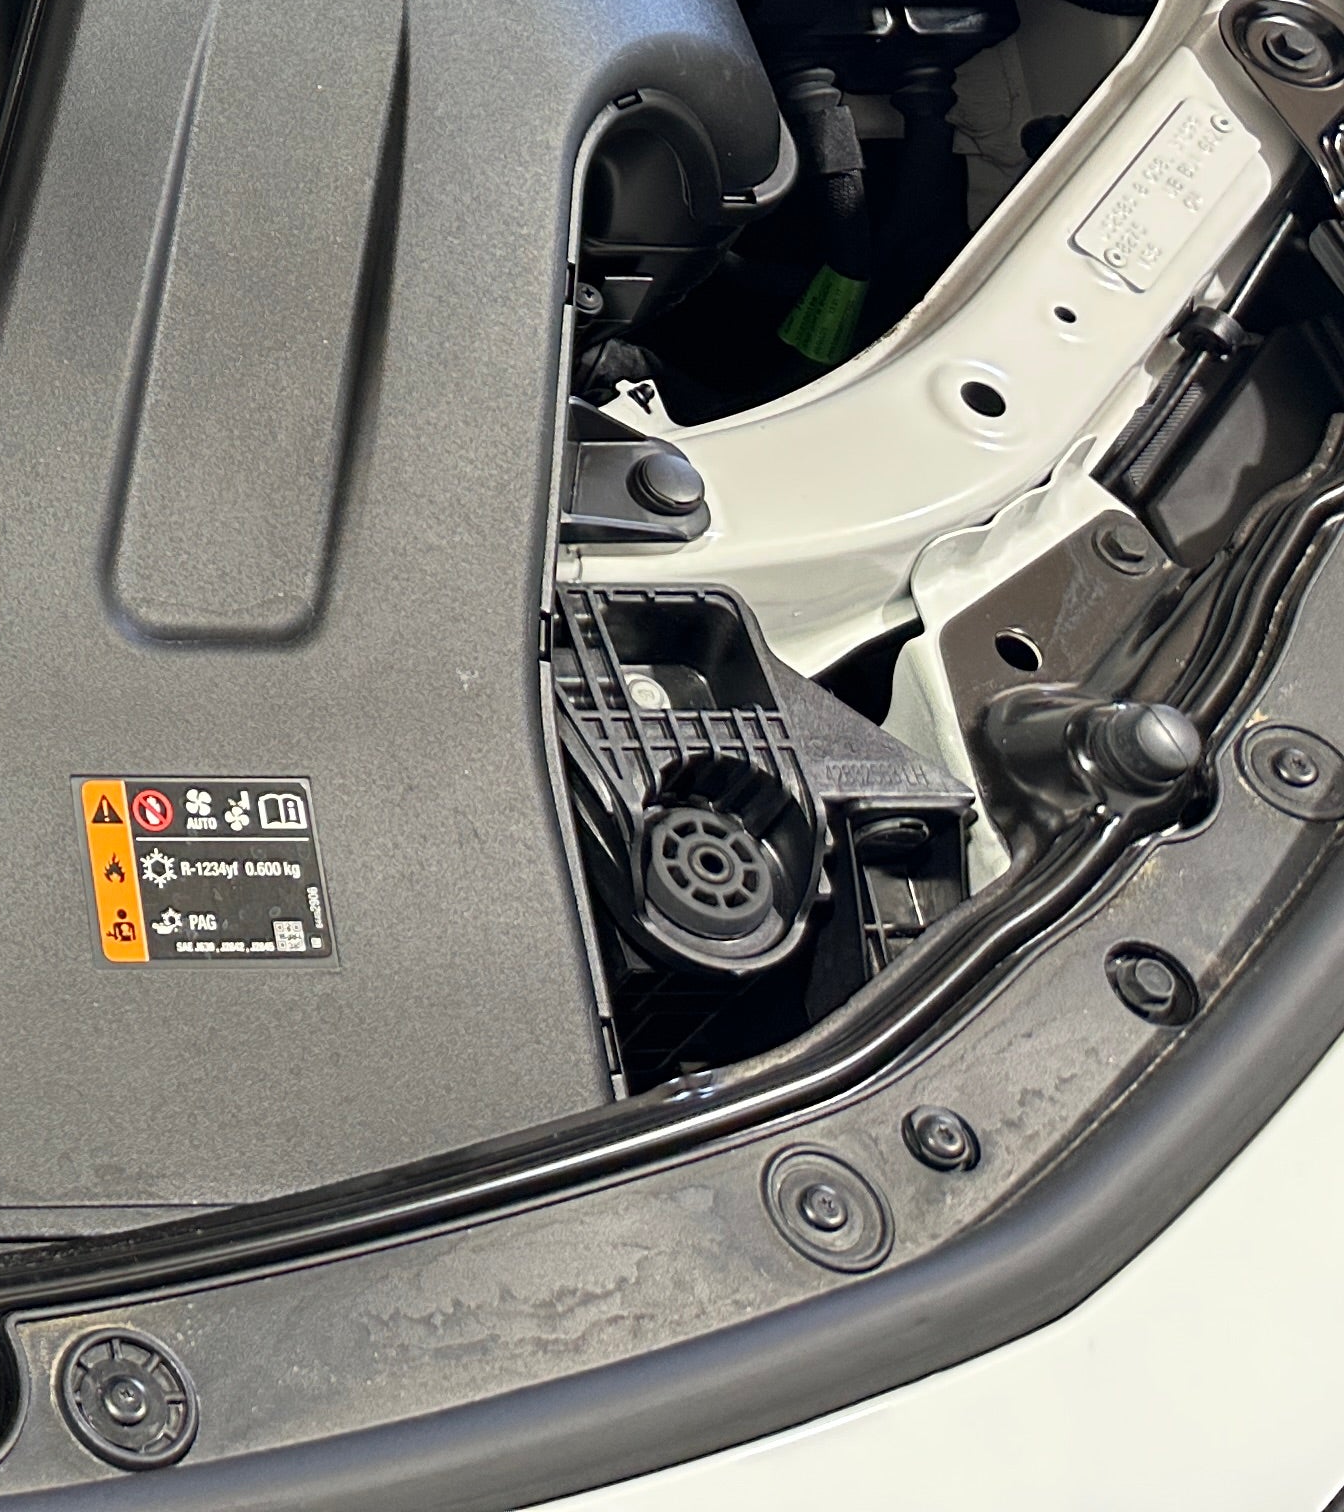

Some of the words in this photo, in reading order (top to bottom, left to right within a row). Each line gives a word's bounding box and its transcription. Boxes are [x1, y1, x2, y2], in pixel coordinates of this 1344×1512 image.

[187, 817, 218, 830] AUTO
[180, 861, 239, 879] R-1234yf
[245, 861, 281, 876] 0.600
[283, 861, 301, 879] kg
[188, 914, 217, 930] PAG
[176, 941, 194, 952] SAE
